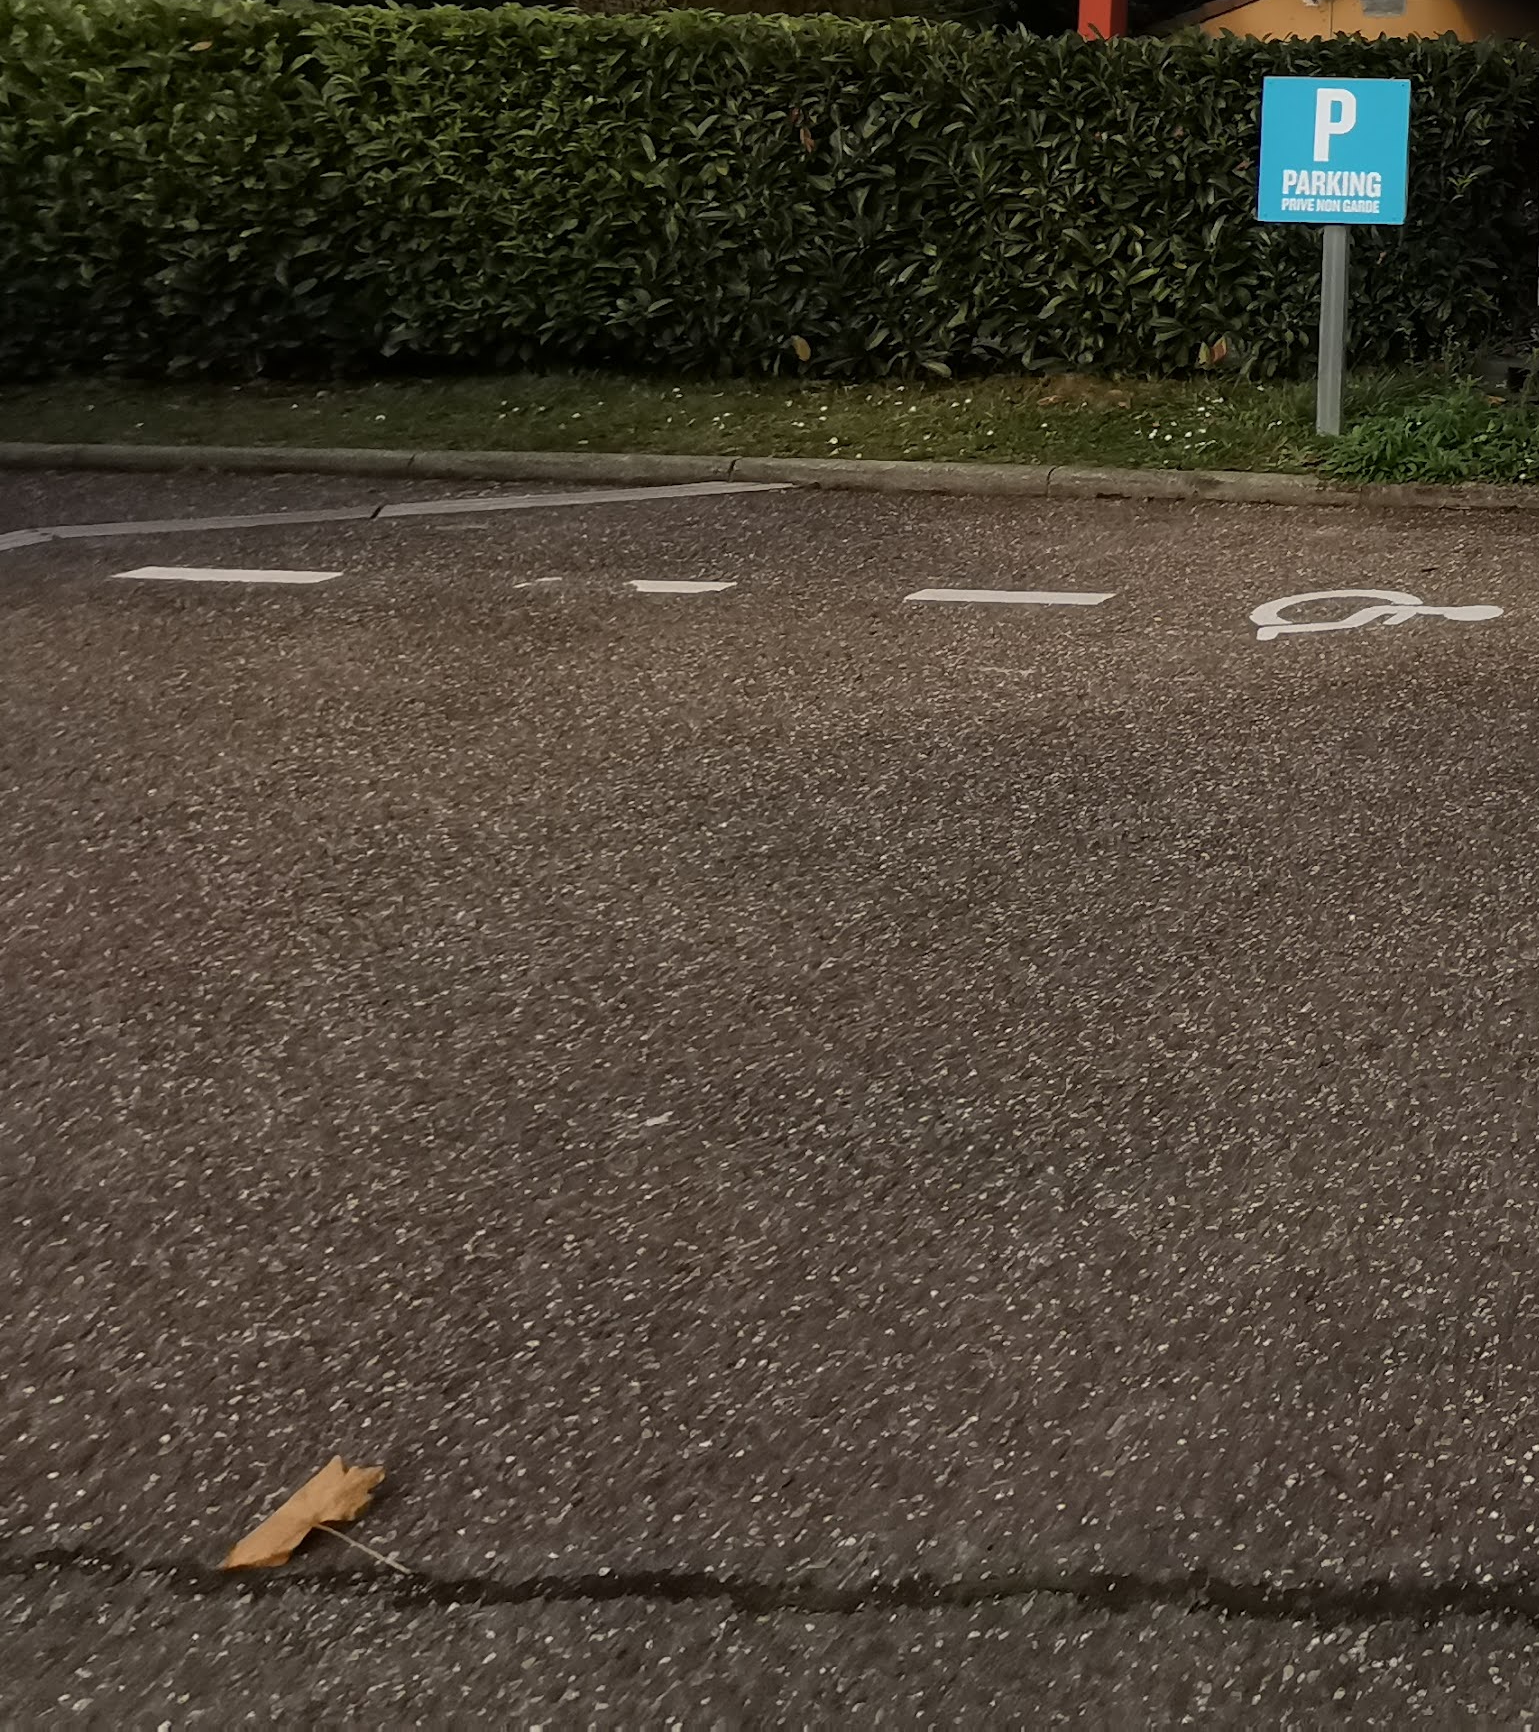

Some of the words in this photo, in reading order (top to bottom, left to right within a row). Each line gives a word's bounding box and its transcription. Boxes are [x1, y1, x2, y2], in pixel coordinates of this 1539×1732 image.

[1313, 88, 1357, 163] P
[1282, 169, 1382, 198] PARKING
[1281, 198, 1315, 211] PRIVE
[1316, 199, 1341, 213] NON
[1342, 200, 1380, 214] GARDE
